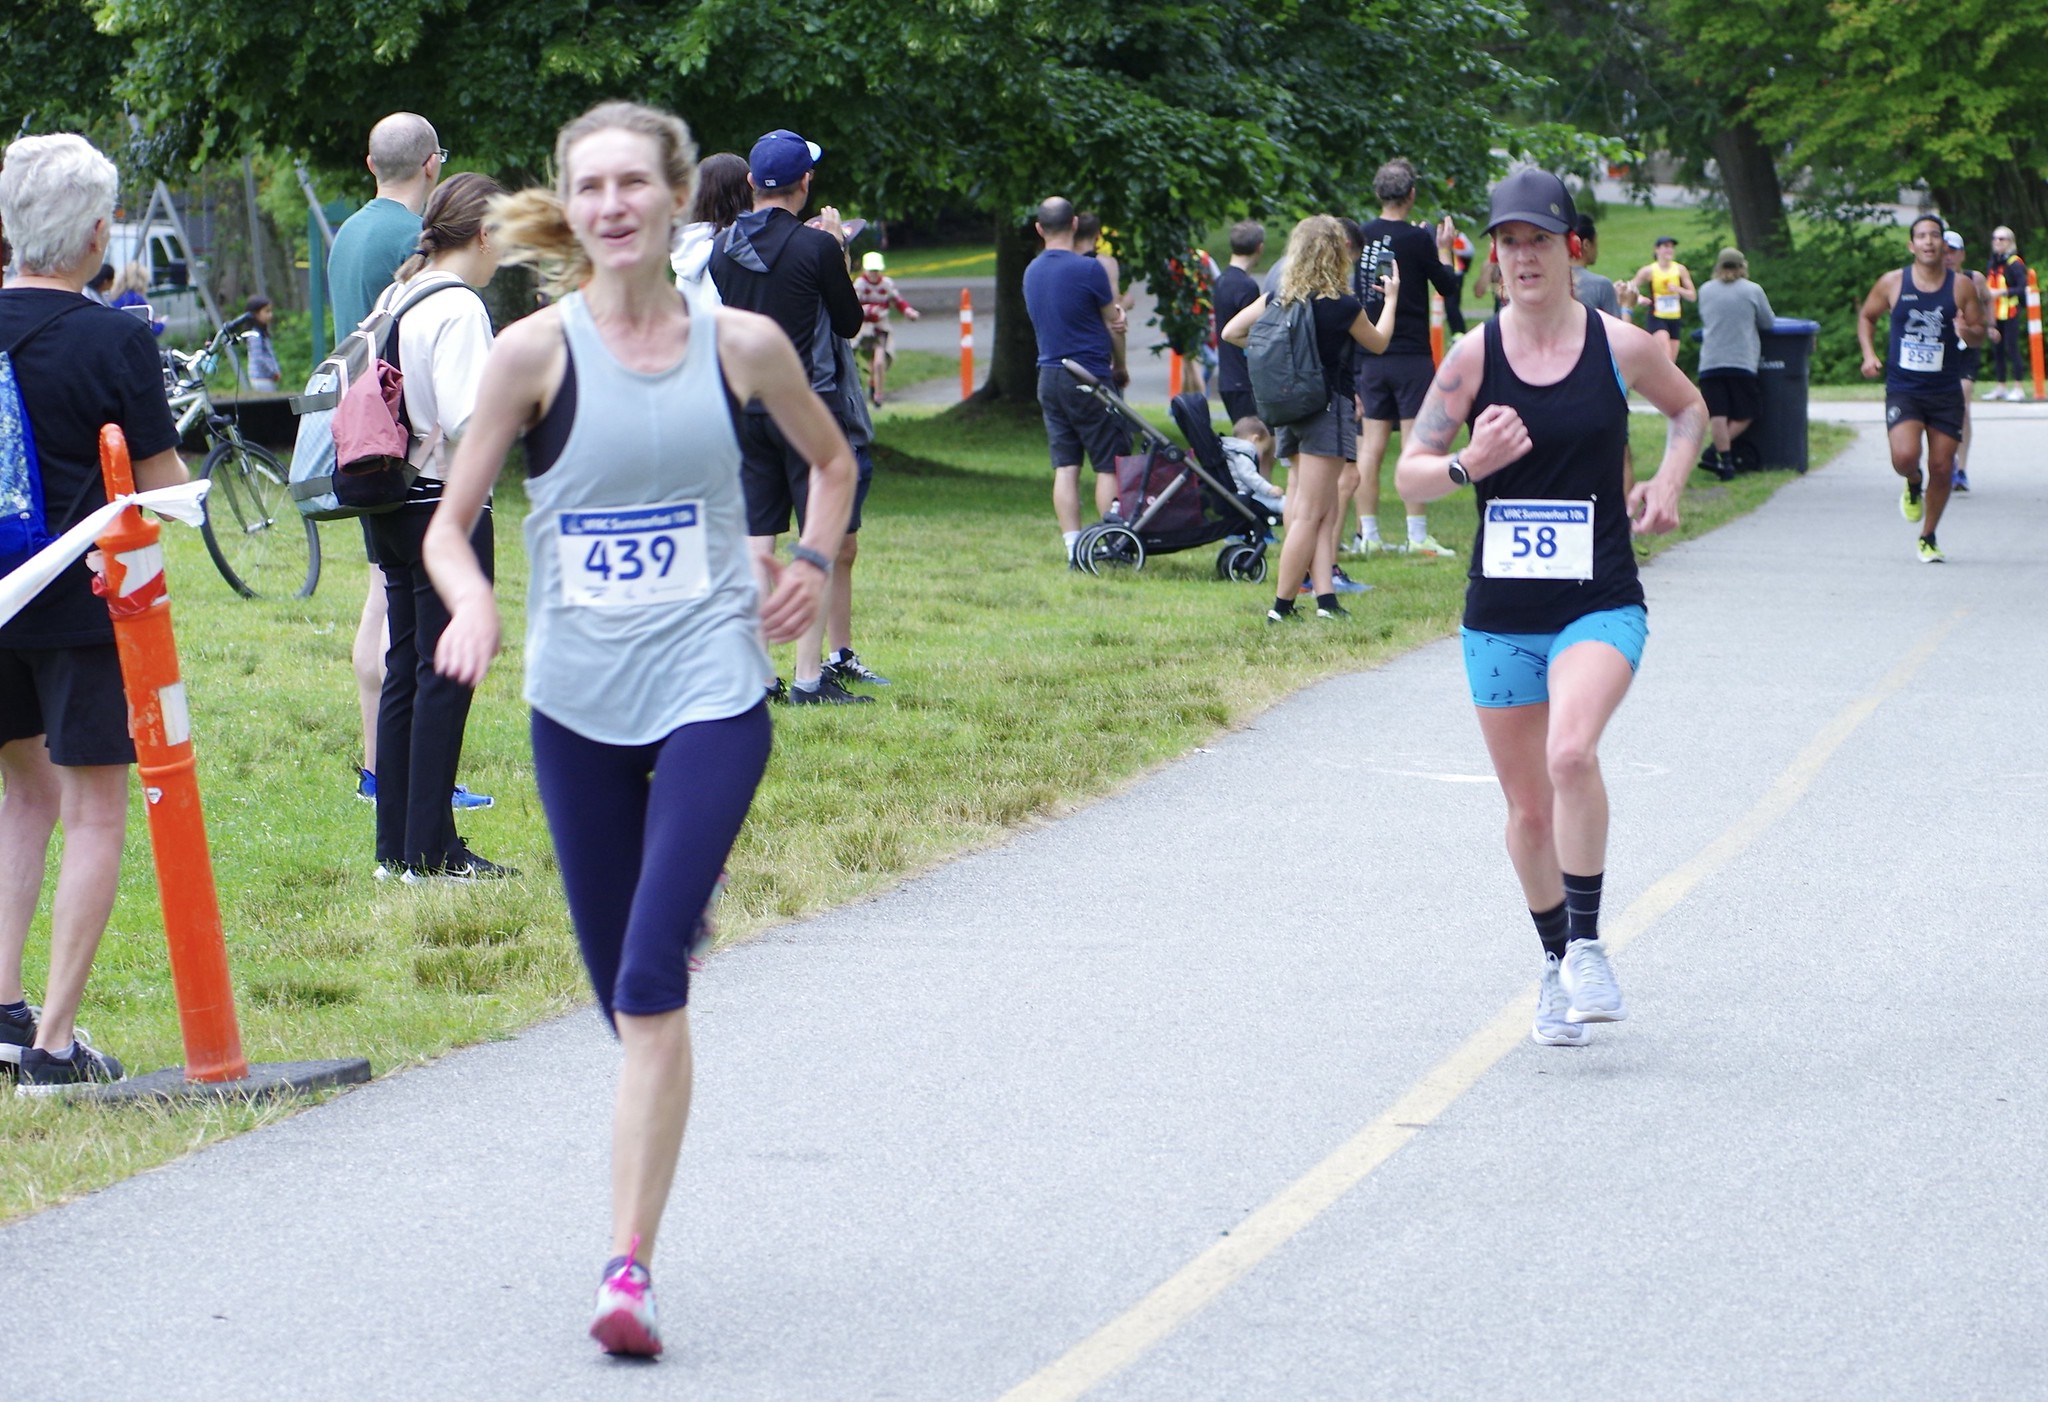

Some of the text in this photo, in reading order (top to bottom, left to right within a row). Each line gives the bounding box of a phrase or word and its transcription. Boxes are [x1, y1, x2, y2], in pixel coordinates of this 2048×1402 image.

[1368, 240, 1381, 270] YOUR
[1908, 350, 1934, 364] 252
[585, 535, 676, 580] 439
[1512, 526, 1557, 558] 58
